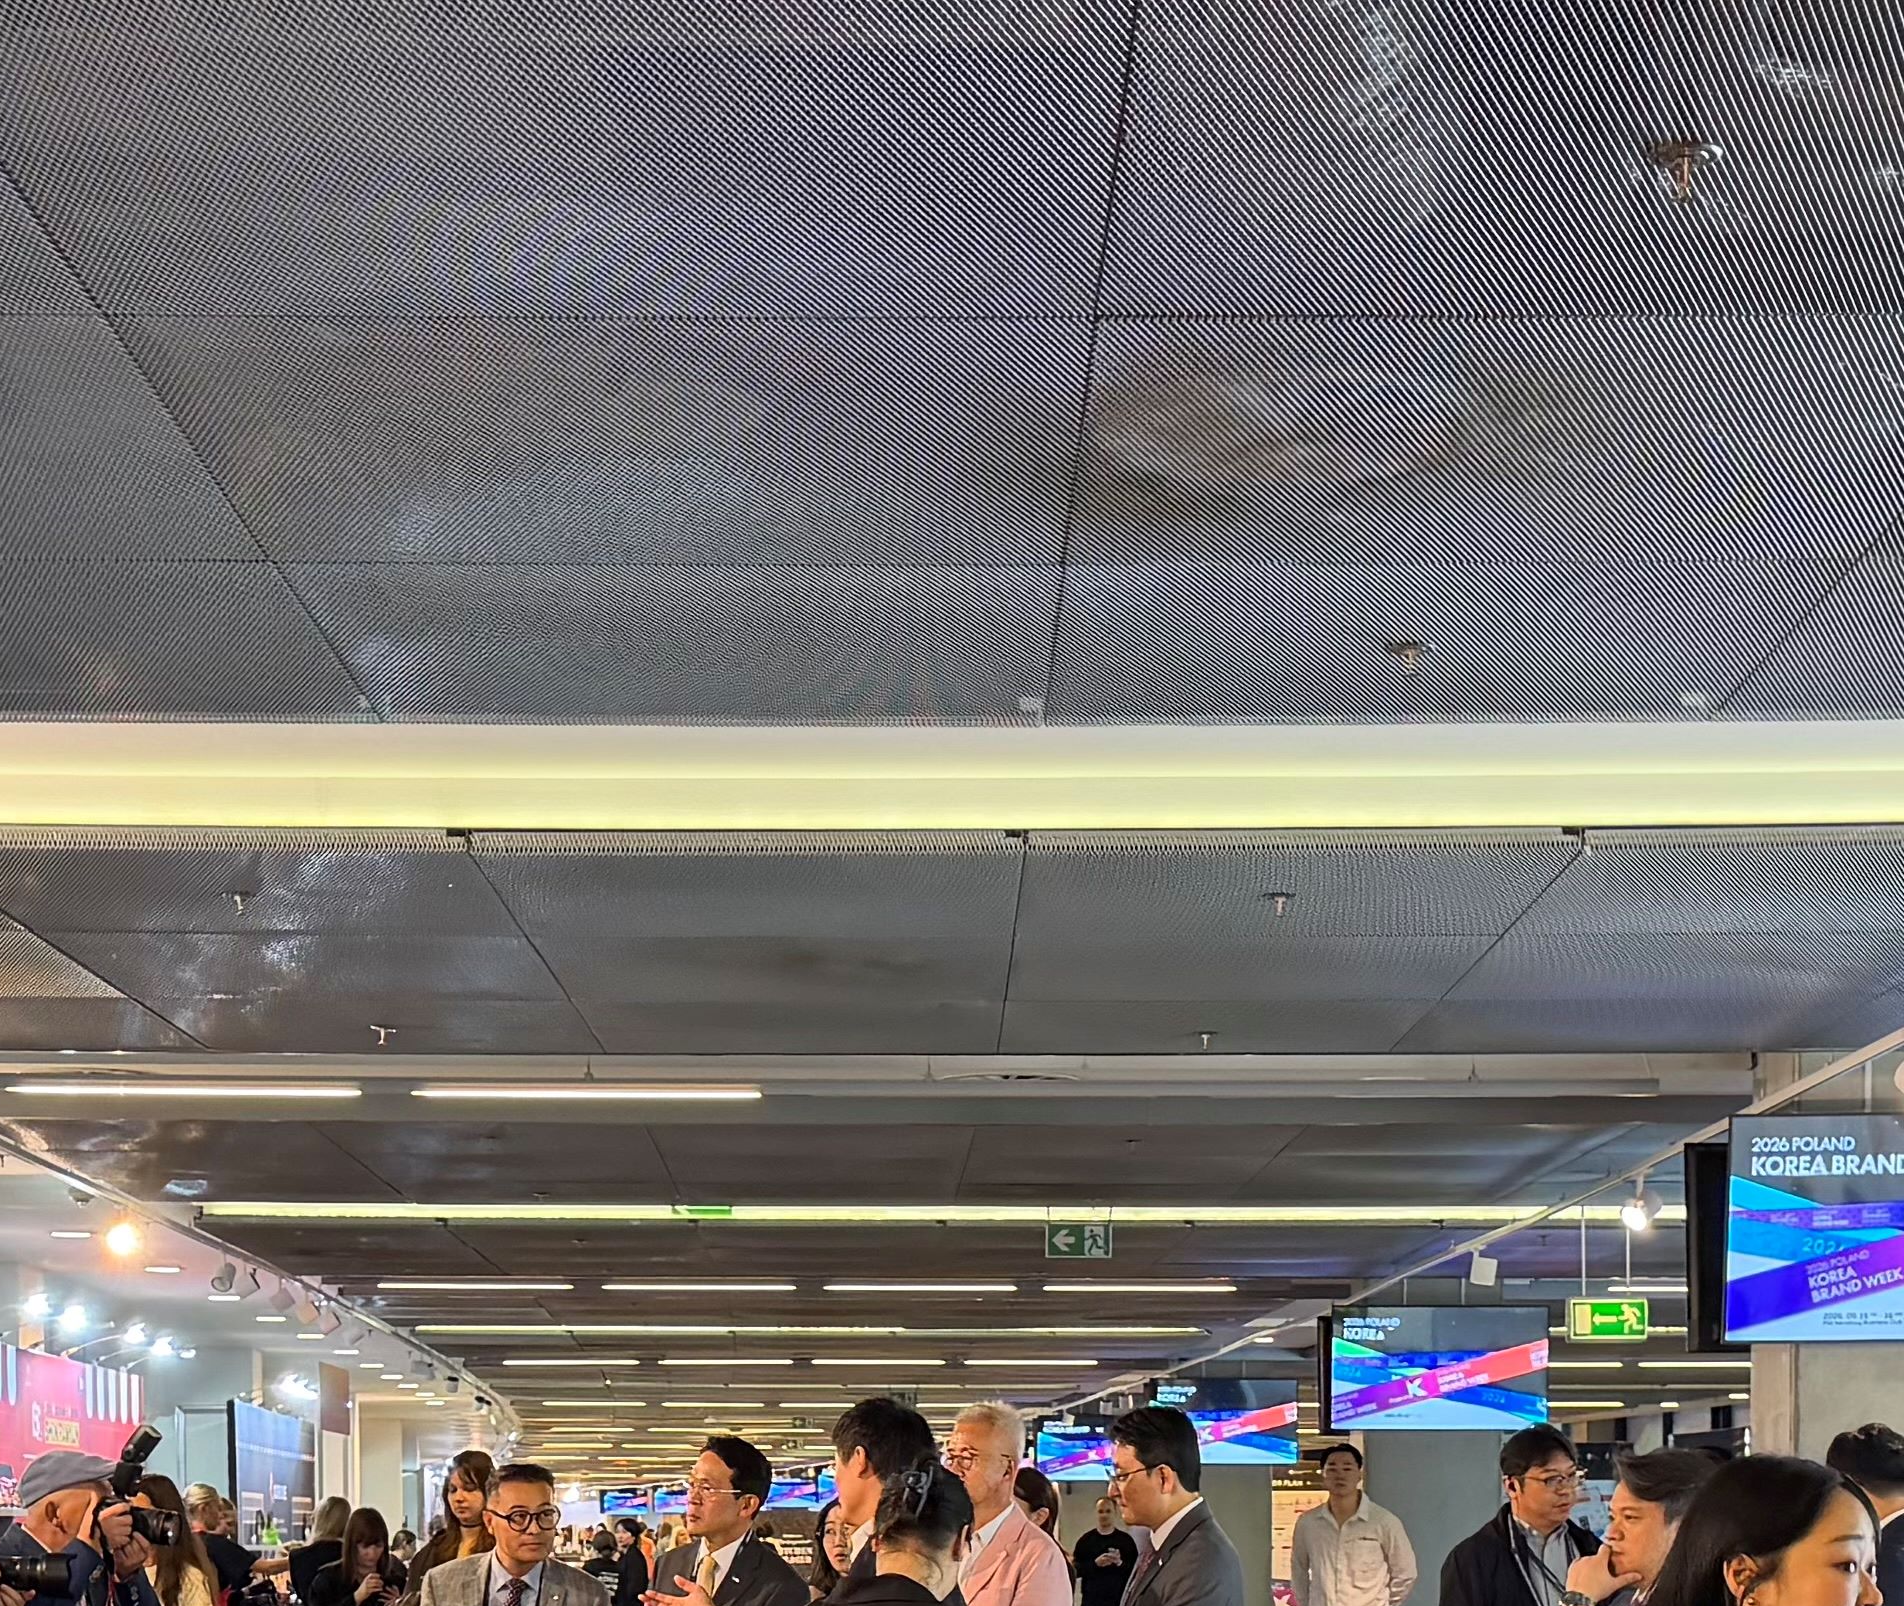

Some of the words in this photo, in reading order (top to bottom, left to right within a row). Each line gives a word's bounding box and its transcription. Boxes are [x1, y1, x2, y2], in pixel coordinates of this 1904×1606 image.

[1751, 1137, 1790, 1152] 2026
[1792, 1136, 1855, 1151] POLAND
[1751, 1154, 1829, 1176] KOREA
[1808, 1266, 1857, 1290] KOREA
[1811, 1279, 1862, 1304] BRAND
[1863, 1267, 1904, 1289] WEEK
